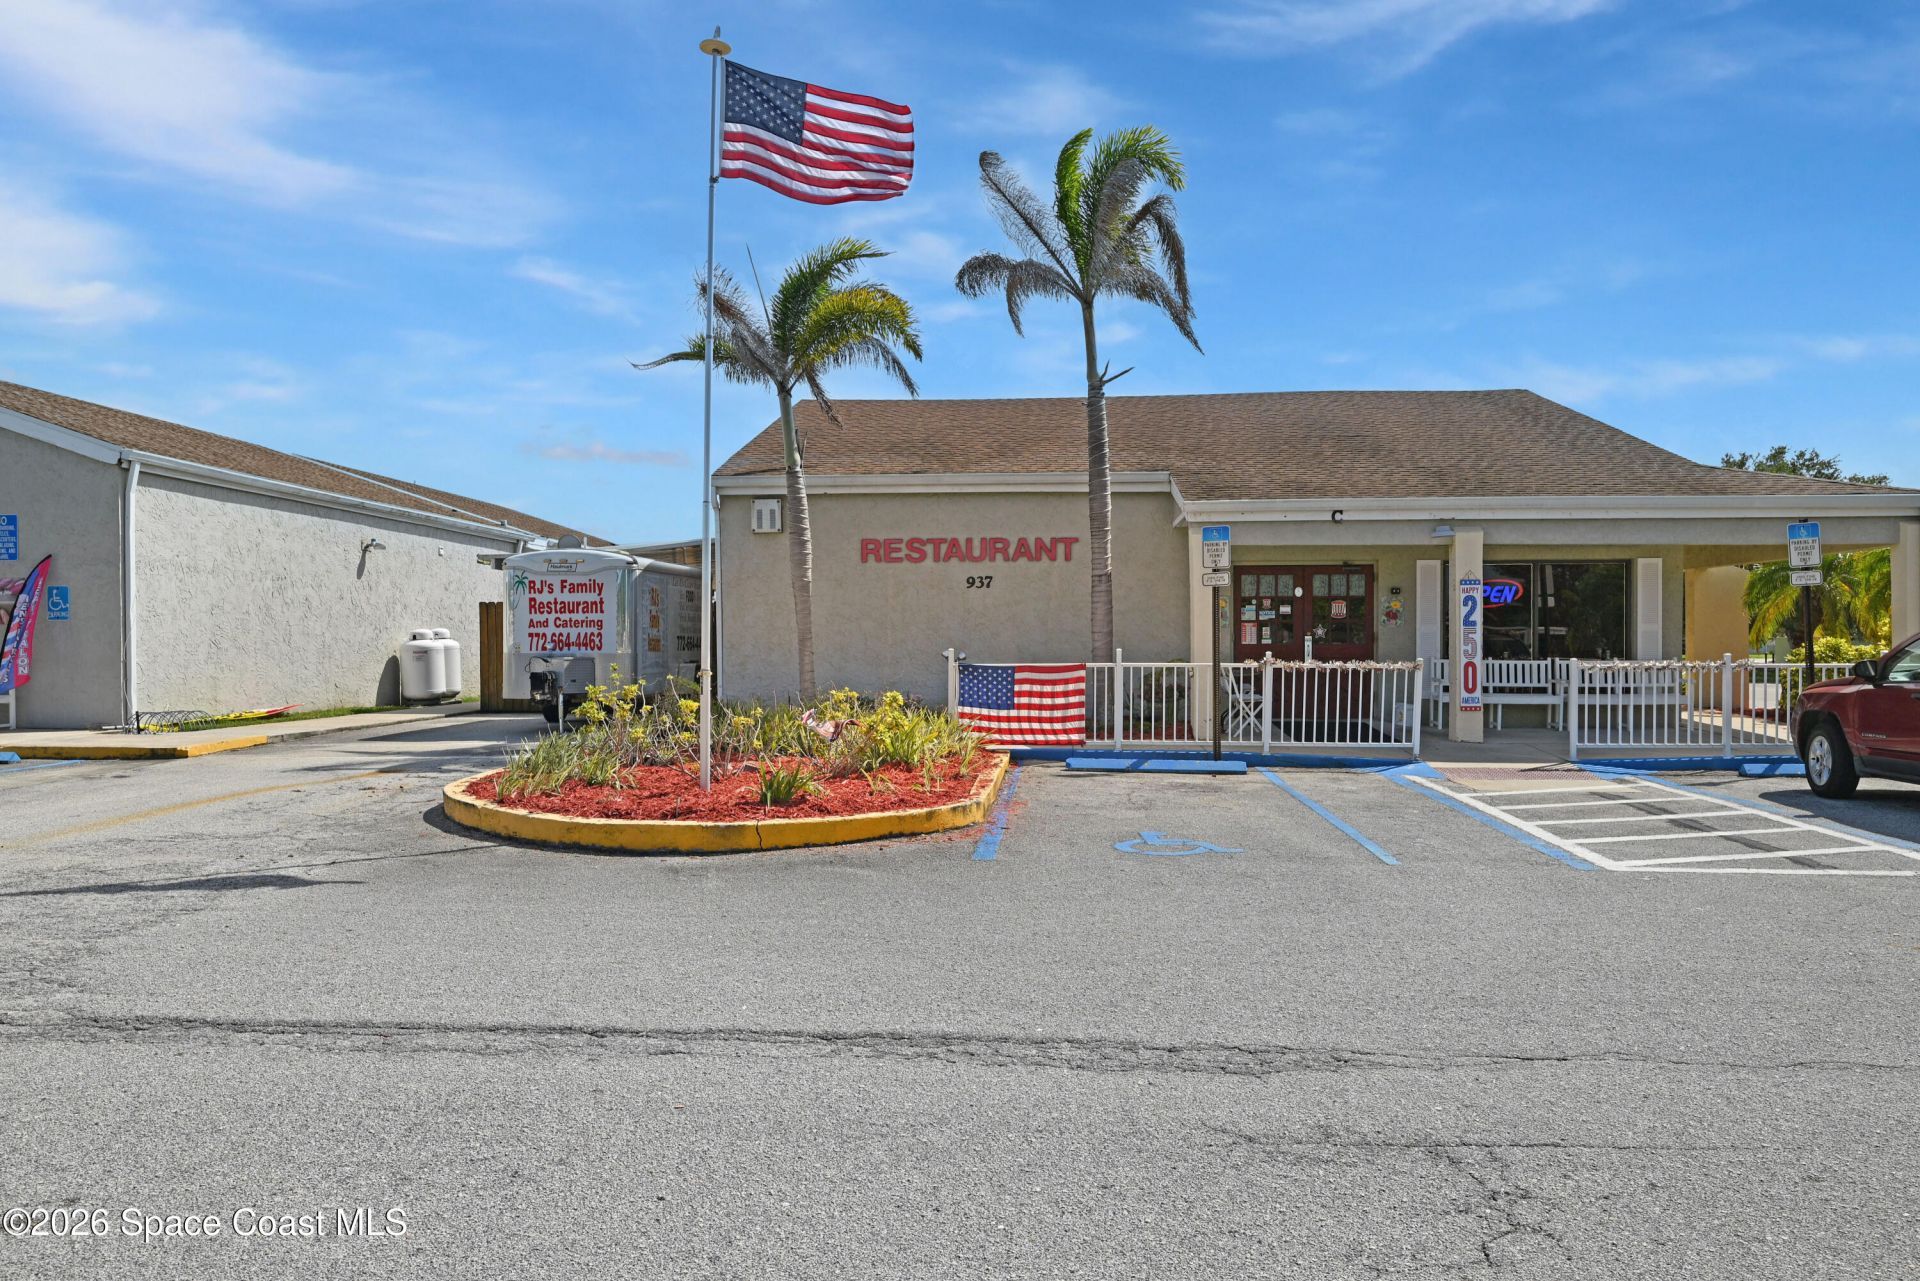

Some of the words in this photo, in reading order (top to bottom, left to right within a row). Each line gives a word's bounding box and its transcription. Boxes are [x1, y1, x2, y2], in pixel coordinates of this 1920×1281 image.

[860, 537, 1079, 563] RESTAURANT
[528, 580, 554, 594] RJ's
[560, 579, 604, 596] Family
[966, 576, 993, 589] 937
[1482, 585, 1517, 603] PEN
[528, 597, 604, 614] Restaurant
[528, 618, 549, 628] And
[554, 617, 603, 630] Catering
[1461, 696, 1480, 704] AMERICA
